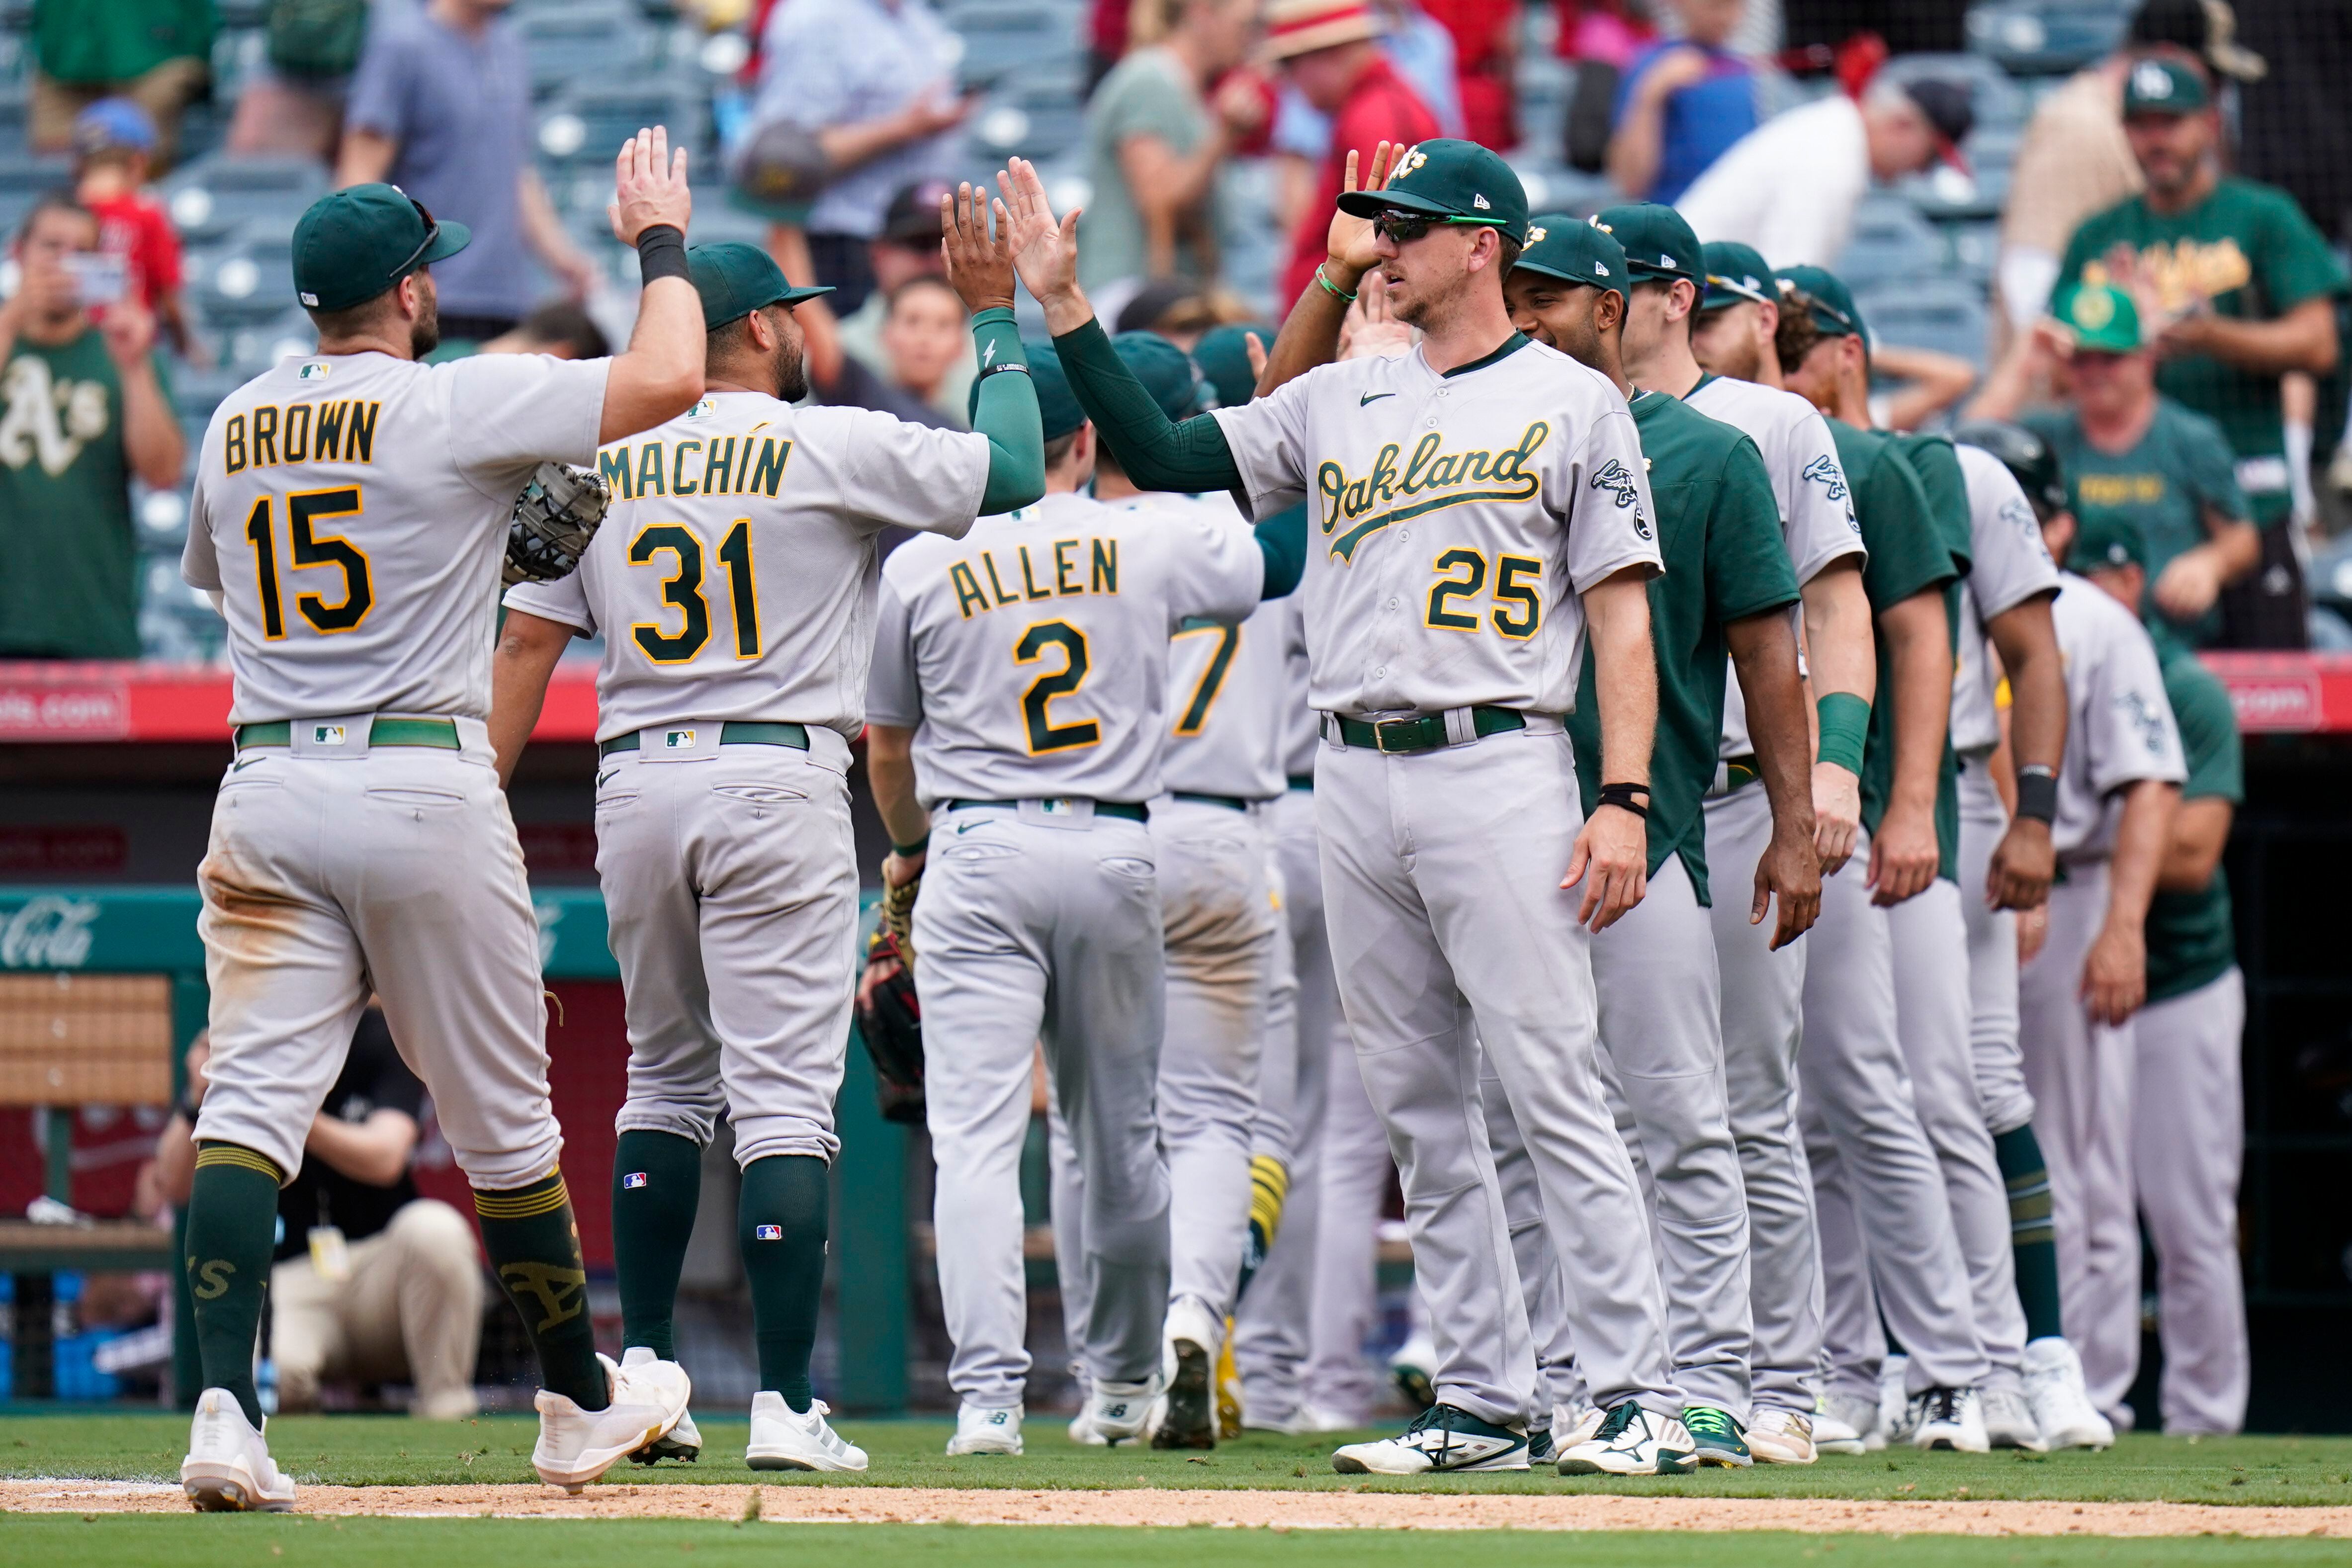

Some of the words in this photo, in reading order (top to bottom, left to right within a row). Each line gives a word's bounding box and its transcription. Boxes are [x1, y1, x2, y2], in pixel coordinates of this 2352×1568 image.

[225, 399, 382, 477] BROWN
[598, 422, 794, 504] MACHÍN
[1317, 420, 1550, 536] Oakland
[245, 483, 376, 641] 15
[627, 518, 763, 665] 31
[948, 537, 1119, 620] ALLEN
[1424, 547, 1542, 641] 25
[1013, 617, 1102, 758] 2
